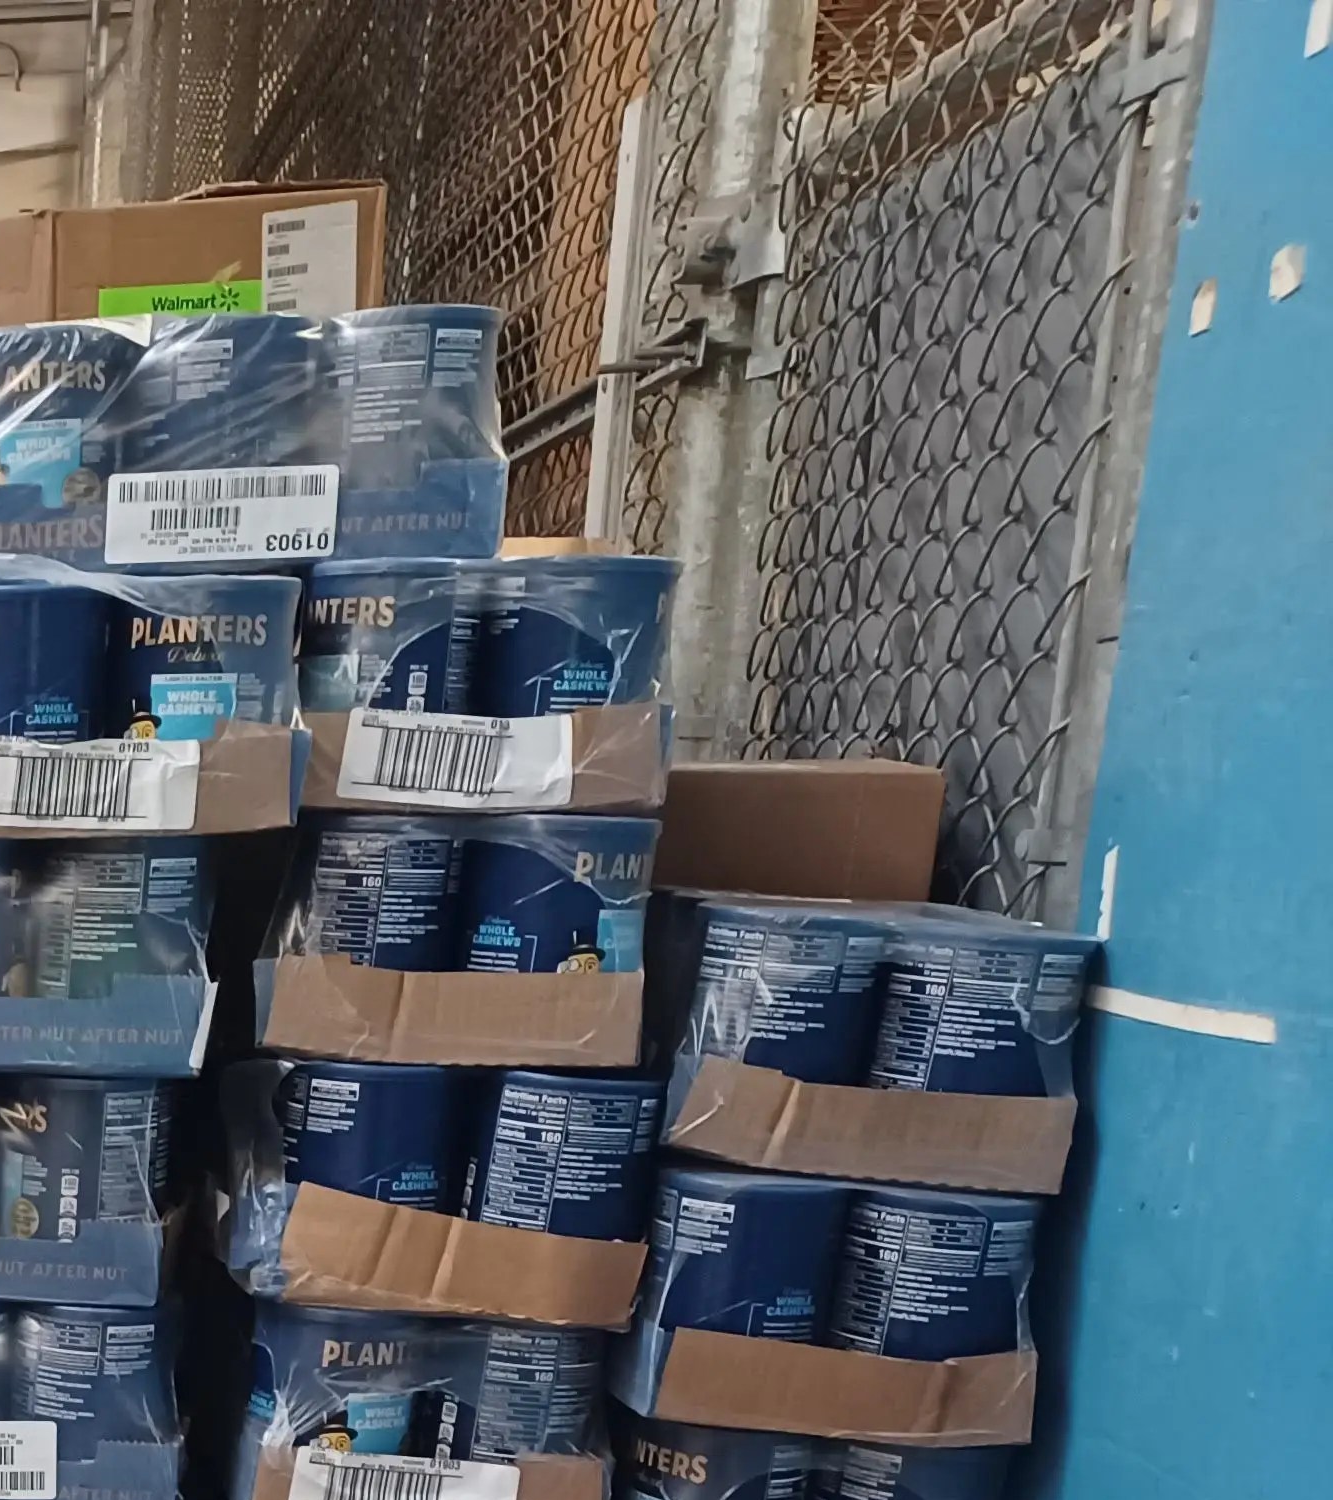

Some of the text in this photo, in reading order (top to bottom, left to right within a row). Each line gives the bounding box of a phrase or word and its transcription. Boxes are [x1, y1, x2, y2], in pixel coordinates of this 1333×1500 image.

[151, 292, 217, 313] Walmart
[265, 531, 329, 552] 01903
[132, 614, 267, 649] PLANTERS
[166, 688, 218, 702] WHOLE
[157, 701, 234, 716] CASHEWS
[479, 925, 517, 936] WHOLE
[540, 1131, 562, 1144] 160
[32, 1261, 87, 1279] AFTER
[93, 1262, 129, 1282] NUT
